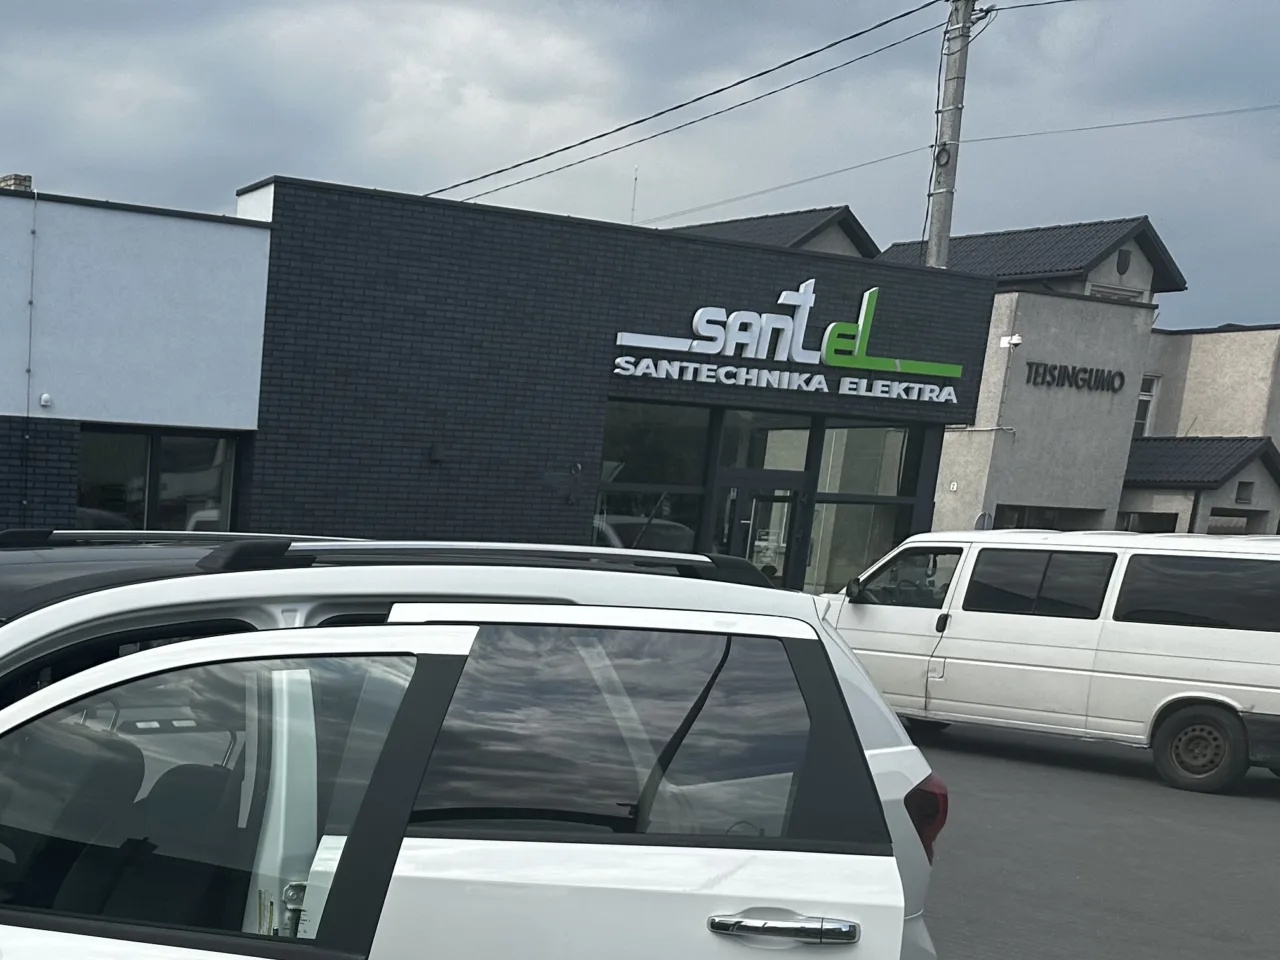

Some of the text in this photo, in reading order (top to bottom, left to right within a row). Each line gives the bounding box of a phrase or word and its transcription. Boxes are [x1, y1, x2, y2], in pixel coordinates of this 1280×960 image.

[614, 356, 958, 403] SANTECHNIKA ELEKTRA
[1026, 361, 1125, 393] TEISINGUMO
